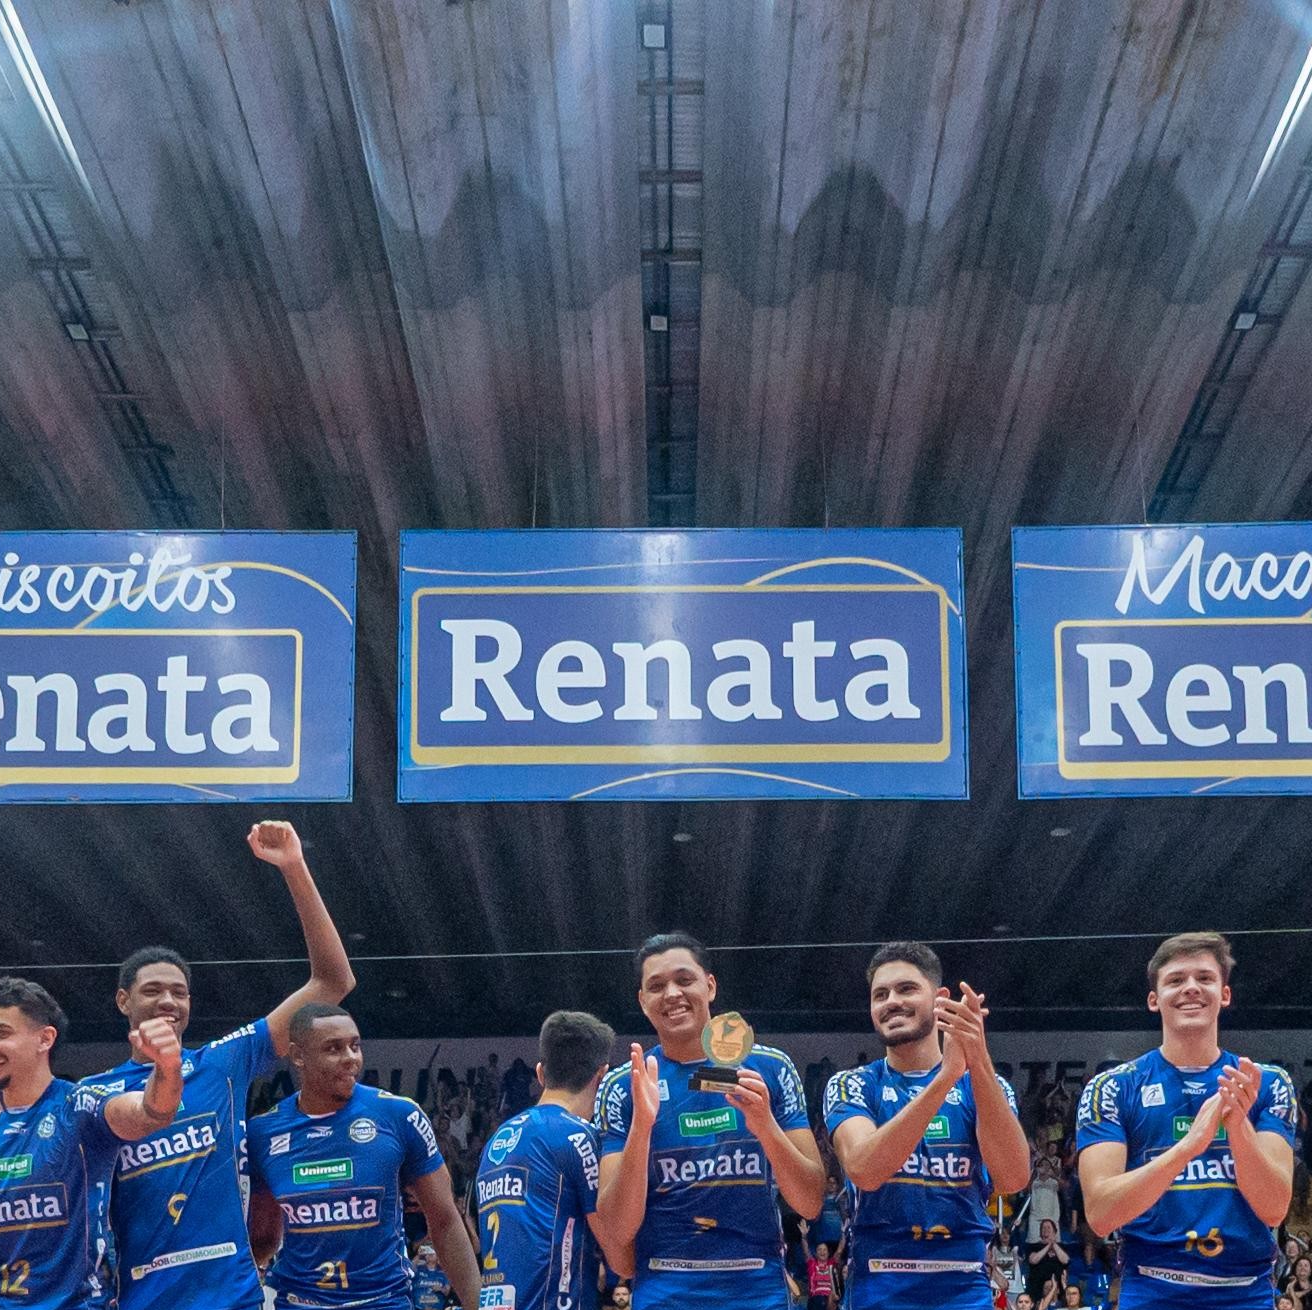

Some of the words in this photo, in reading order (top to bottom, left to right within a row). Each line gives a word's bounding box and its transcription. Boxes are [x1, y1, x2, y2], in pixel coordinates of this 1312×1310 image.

[440, 619, 921, 723] Renata
[685, 1113, 730, 1128] Unimed
[119, 1124, 216, 1173] Renata
[567, 1132, 600, 1191] ADERE
[299, 1163, 347, 1177] Unimed
[658, 1148, 762, 1184] Renata
[477, 1175, 523, 1204] Renata
[168, 1193, 188, 1226] 9
[280, 1196, 377, 1225] Renata
[0, 1260, 31, 1295] 12
[315, 1260, 349, 1289] 21
[660, 1261, 692, 1269] SICOOB
[882, 1262, 917, 1270] SICOOB
